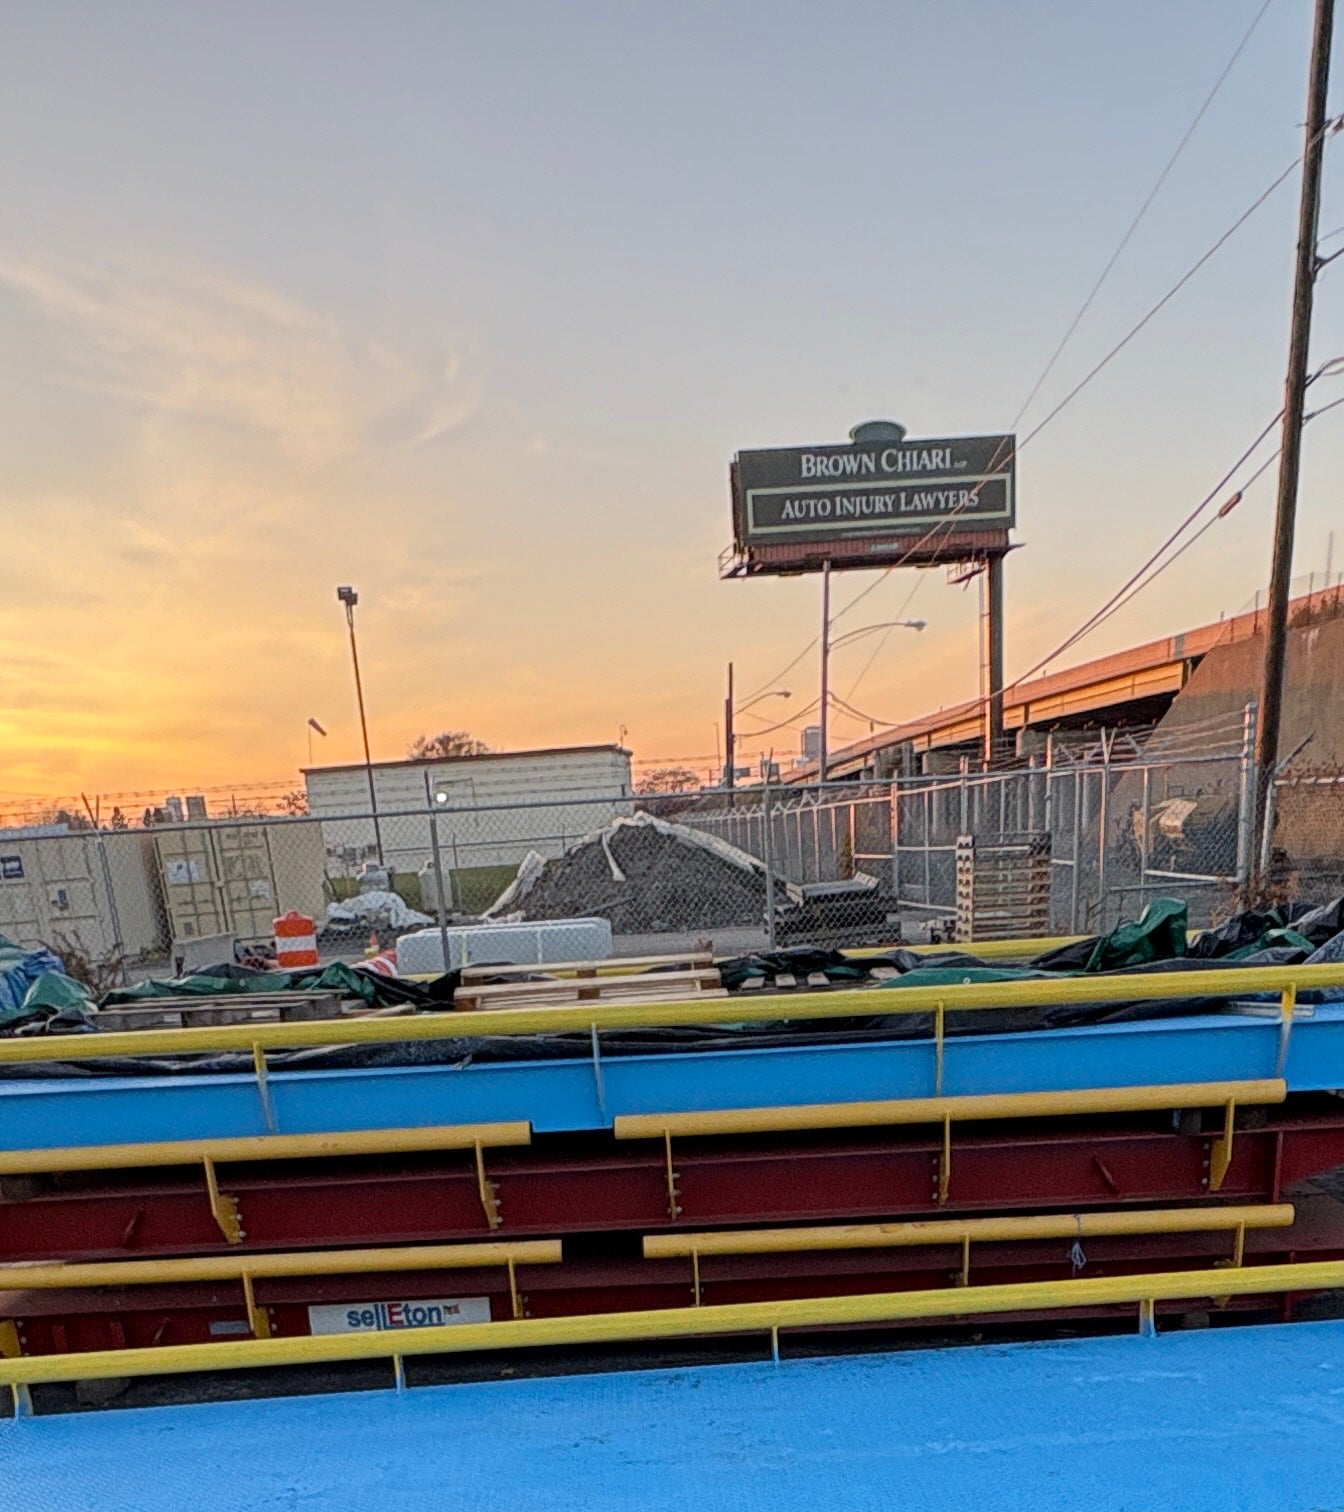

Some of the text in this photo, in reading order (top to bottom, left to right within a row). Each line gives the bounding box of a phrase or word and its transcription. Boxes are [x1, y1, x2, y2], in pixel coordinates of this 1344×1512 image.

[801, 448, 951, 478] BROWN CHIARI
[781, 489, 979, 519] AUTO INJURY LAWYERS
